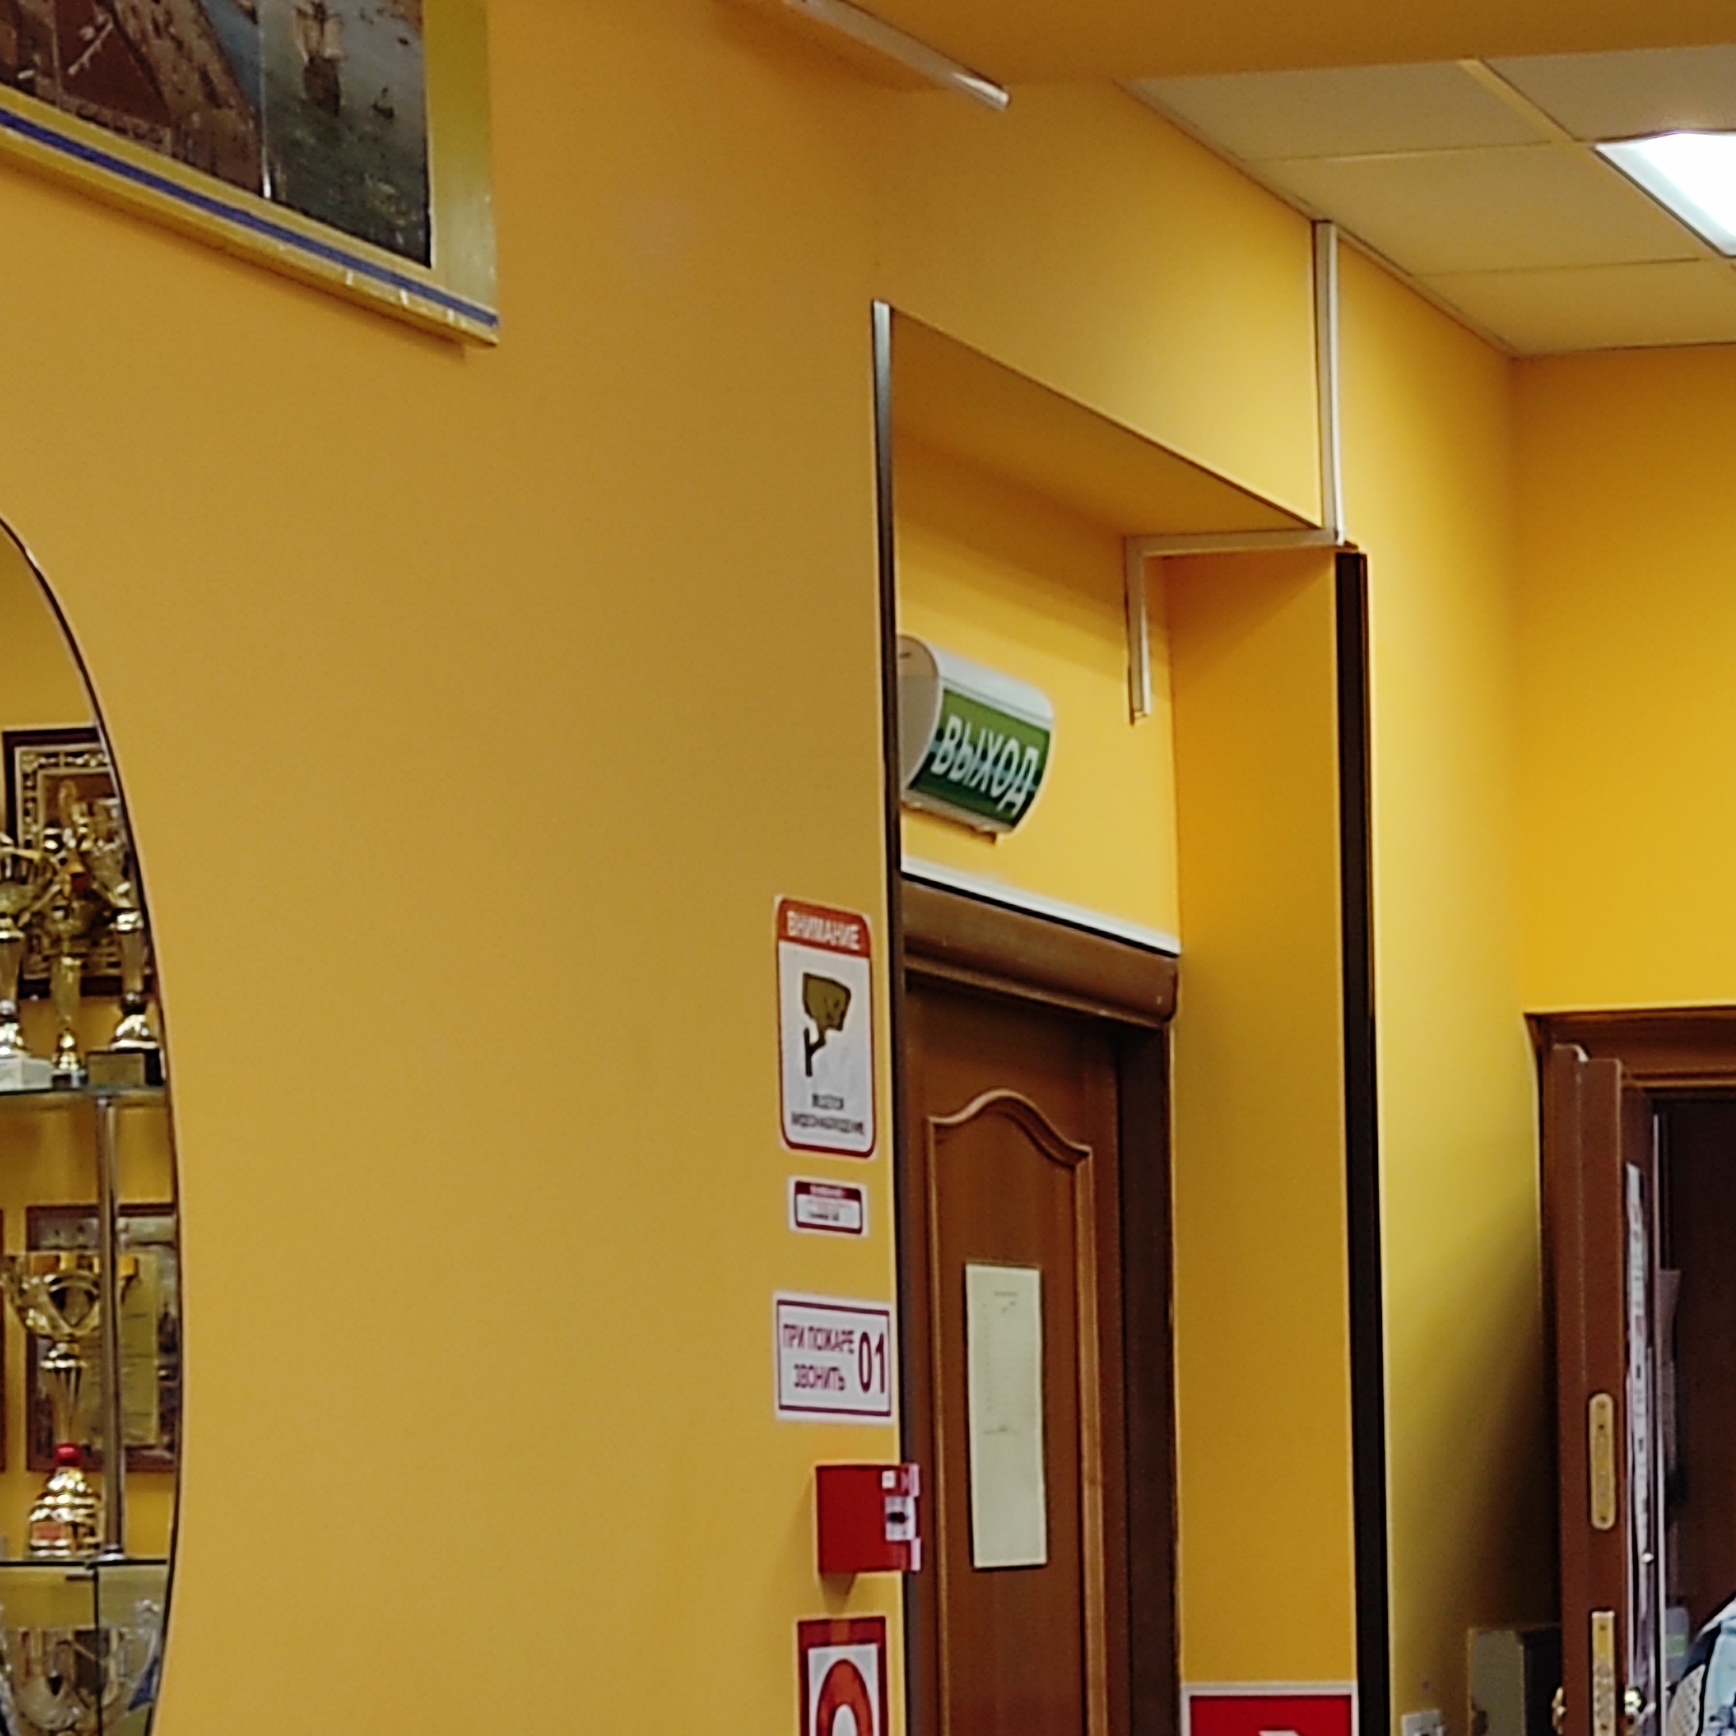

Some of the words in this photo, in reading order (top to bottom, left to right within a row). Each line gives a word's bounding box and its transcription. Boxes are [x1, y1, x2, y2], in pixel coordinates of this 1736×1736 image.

[930, 714, 1040, 816] ВЫХОД
[783, 1323, 805, 1349] ПРИ
[807, 1325, 855, 1355] ПОЖАРЕ
[858, 1330, 886, 1394] 01
[793, 1363, 846, 1391] ЗВОНИТЬ
